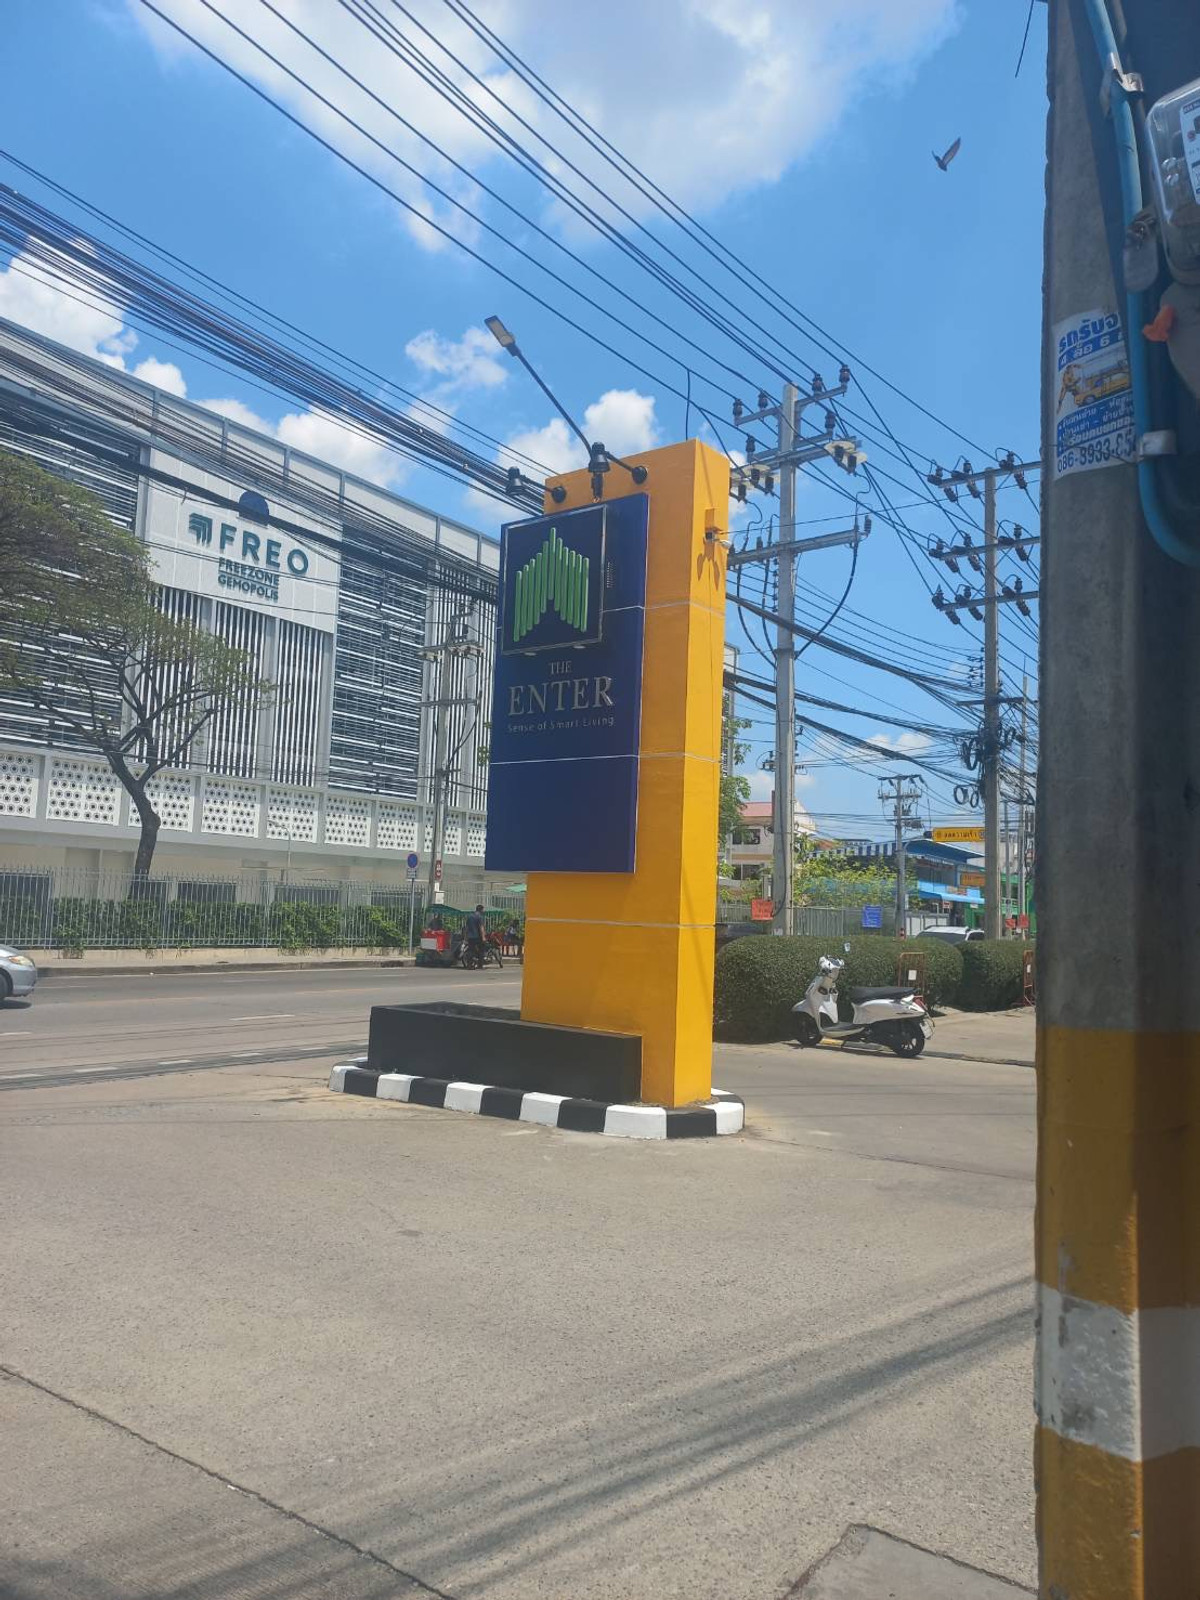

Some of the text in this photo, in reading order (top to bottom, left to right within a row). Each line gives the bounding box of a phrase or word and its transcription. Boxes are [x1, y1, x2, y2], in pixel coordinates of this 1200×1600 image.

[1101, 335, 1110, 347] 6
[219, 522, 309, 575] FREO
[217, 574, 279, 601] GEMOPOLIS
[548, 660, 573, 675] THE
[508, 676, 614, 717] ENTER
[507, 716, 615, 734] Sense of Smart Living
